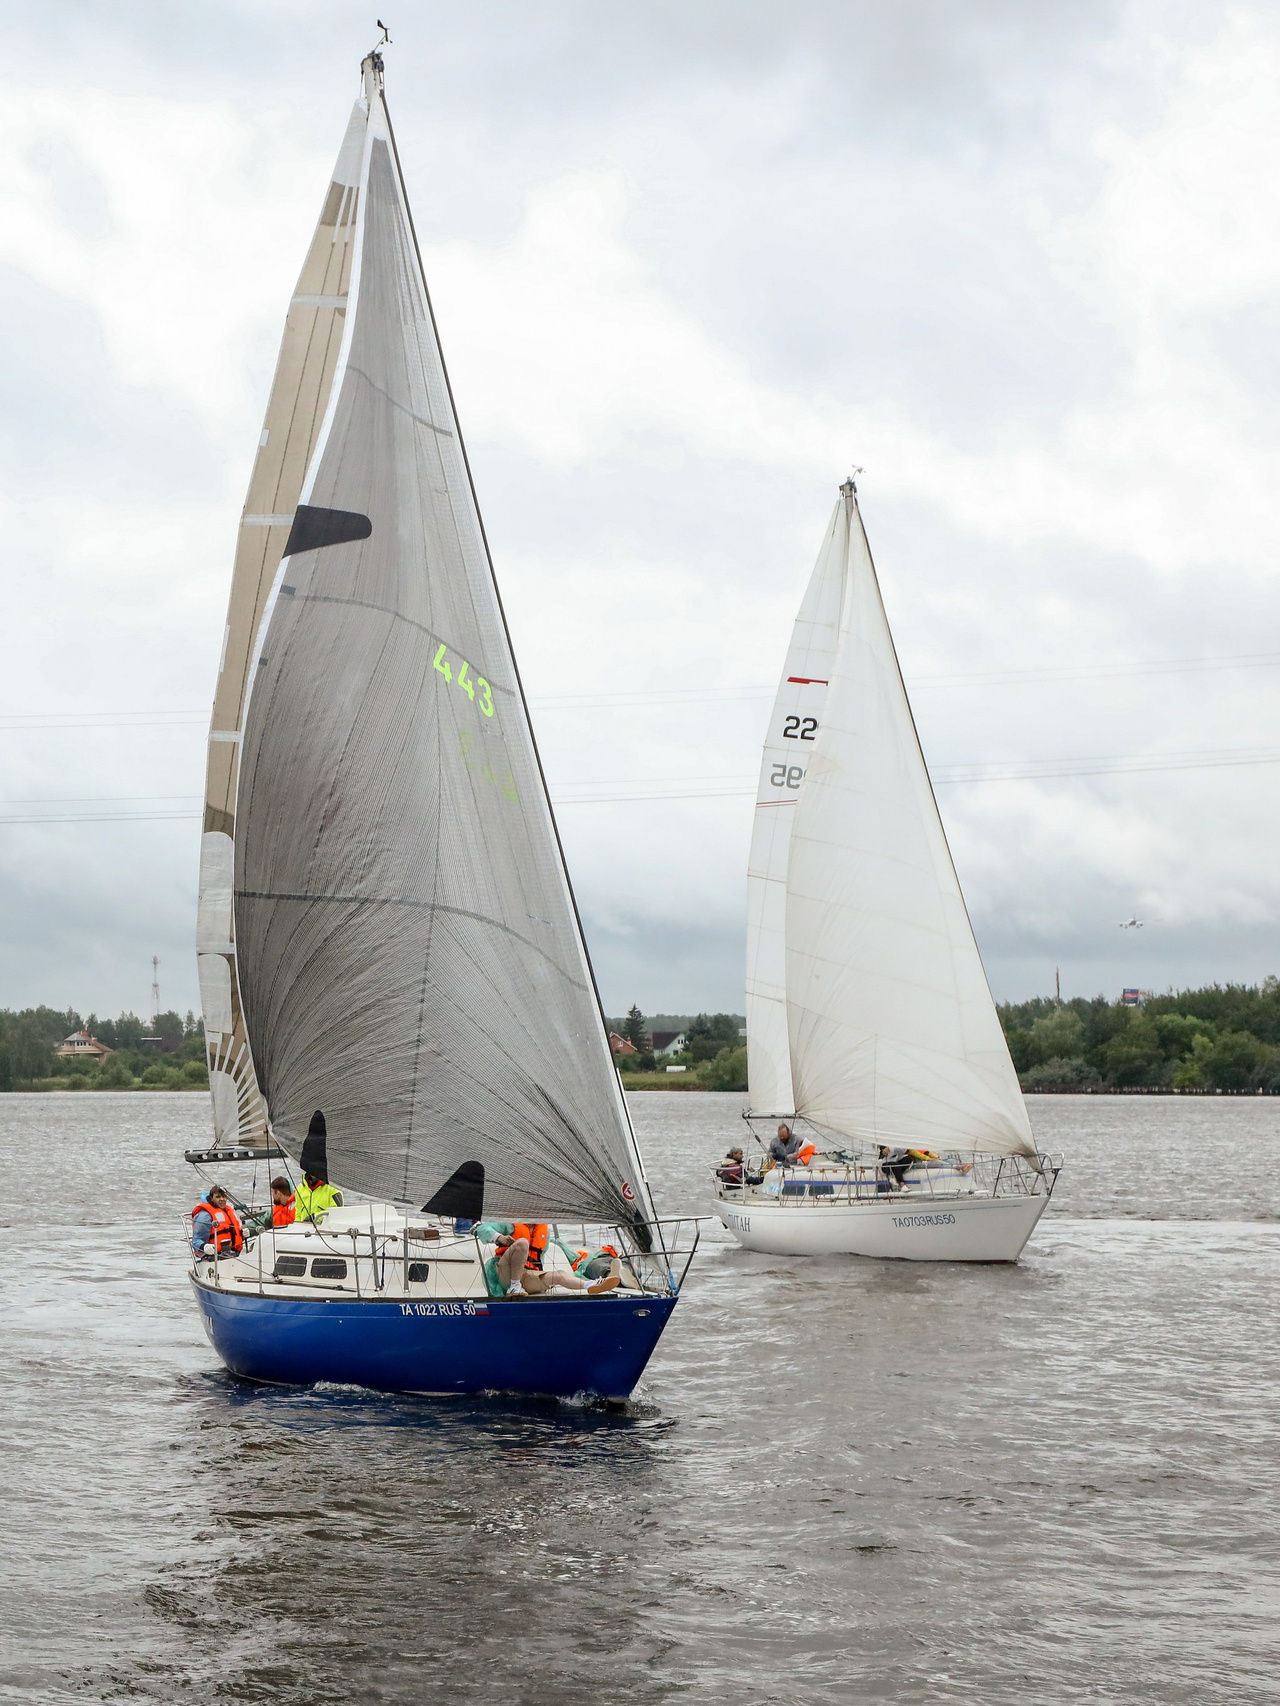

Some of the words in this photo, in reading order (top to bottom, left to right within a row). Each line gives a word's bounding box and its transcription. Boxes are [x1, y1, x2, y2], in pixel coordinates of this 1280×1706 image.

[433, 643, 494, 718] 443
[783, 715, 819, 741] 22
[892, 1213, 956, 1228] TA0703RUS50
[399, 1303, 414, 1316] TA
[414, 1303, 438, 1316] 1022
[438, 1303, 462, 1316] RUS
[463, 1303, 476, 1316] 50
